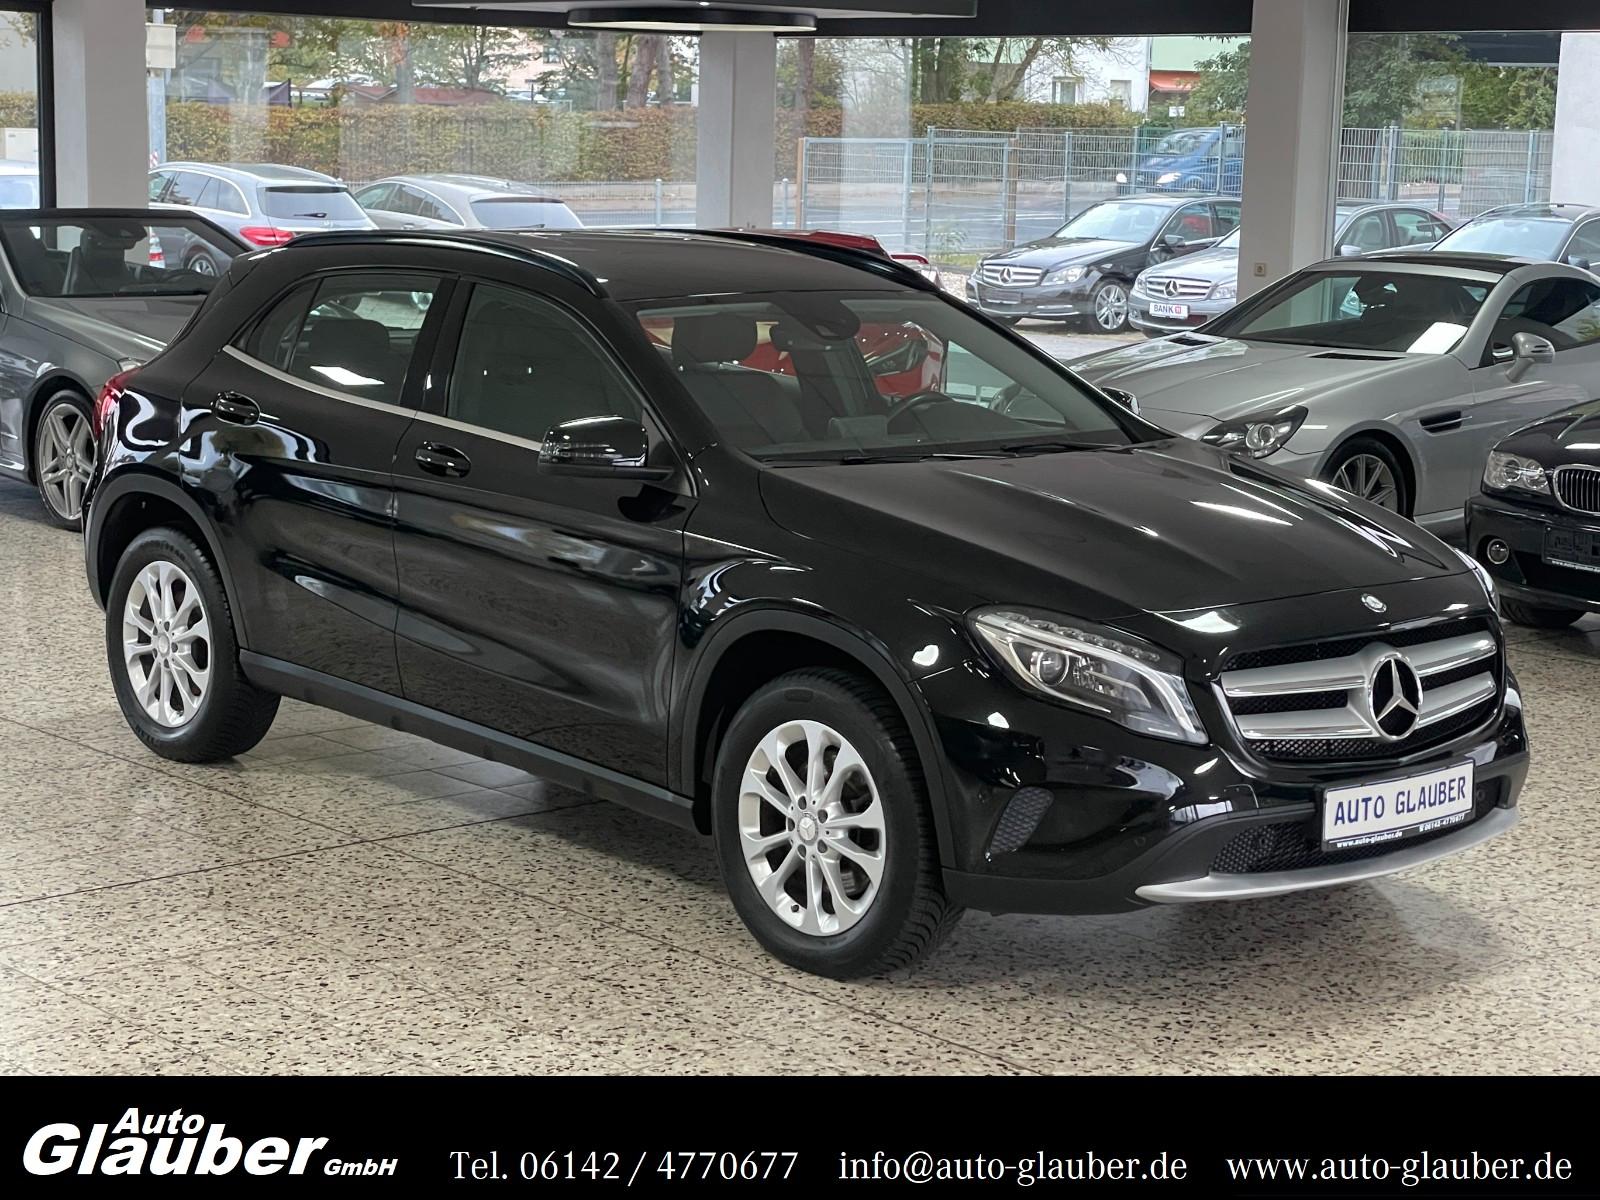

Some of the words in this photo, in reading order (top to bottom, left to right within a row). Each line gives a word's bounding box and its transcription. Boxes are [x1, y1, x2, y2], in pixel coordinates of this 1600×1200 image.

[1153, 304, 1174, 314] BANK
[1334, 795, 1385, 826] AUTO
[1395, 776, 1466, 815] GLAUBER
[1336, 831, 1403, 848] www.auto-glauber.de
